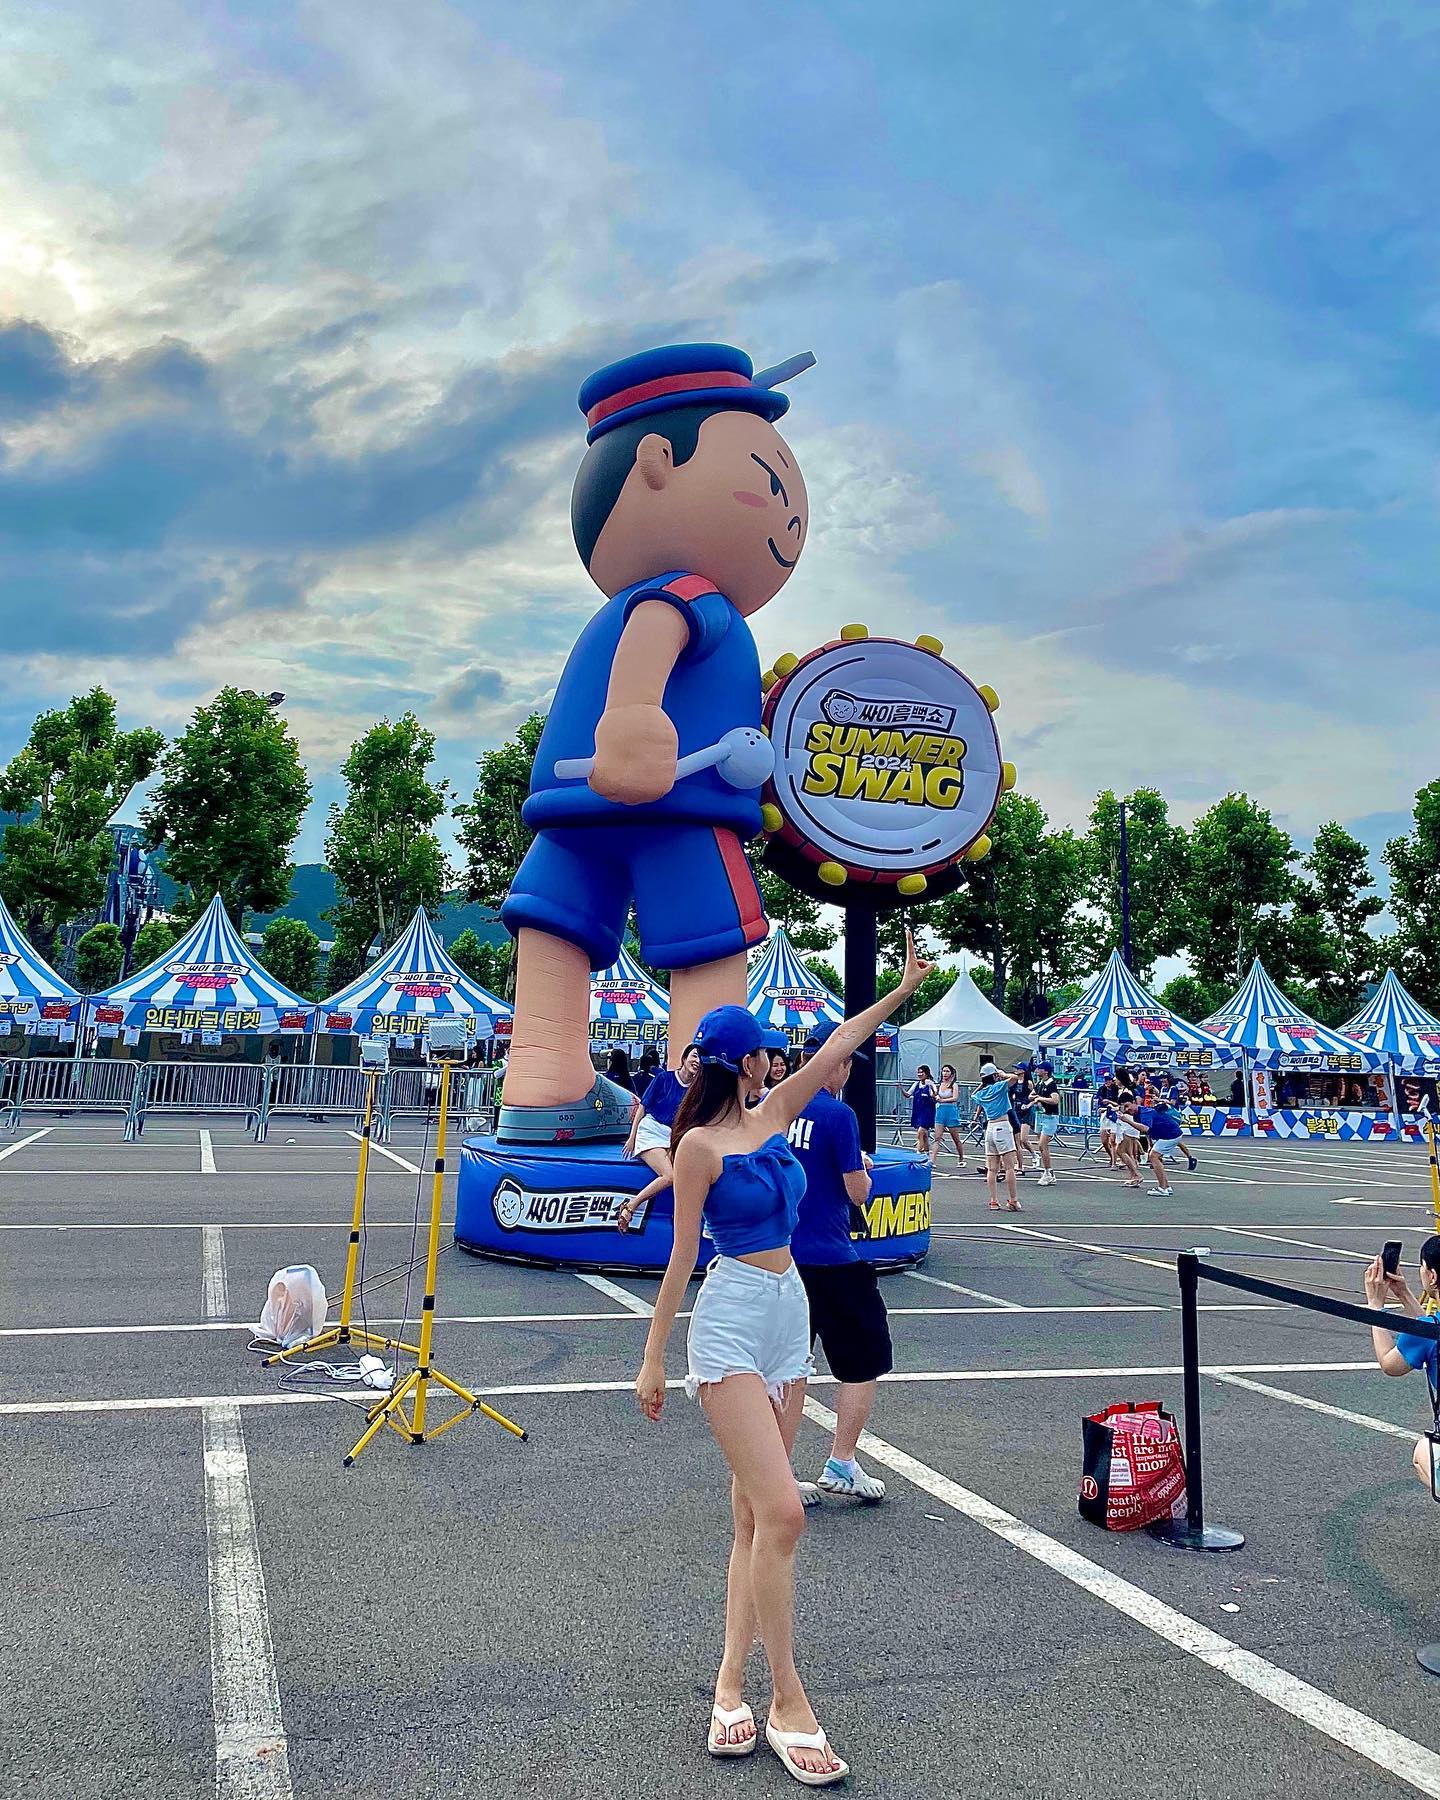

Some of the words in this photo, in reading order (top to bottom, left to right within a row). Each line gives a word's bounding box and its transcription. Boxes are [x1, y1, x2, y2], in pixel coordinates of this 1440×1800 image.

[858, 704, 944, 724] 싸이흠뻑쇼
[807, 723, 965, 767] SUMMER
[861, 755, 912, 772] 2024
[804, 753, 962, 808] SWAG
[176, 976, 238, 985] SUMMER
[395, 984, 451, 993] SUMMER
[406, 990, 441, 998] SWAG
[595, 991, 646, 1000] SUMMER
[778, 999, 825, 1008] SUMMER
[146, 1008, 219, 1028] 인터파크
[224, 1011, 261, 1030] 티켓
[1177, 1051, 1213, 1067] 푸드존
[1327, 1055, 1362, 1069] 푸드존
[1134, 1446, 1155, 1455] are
